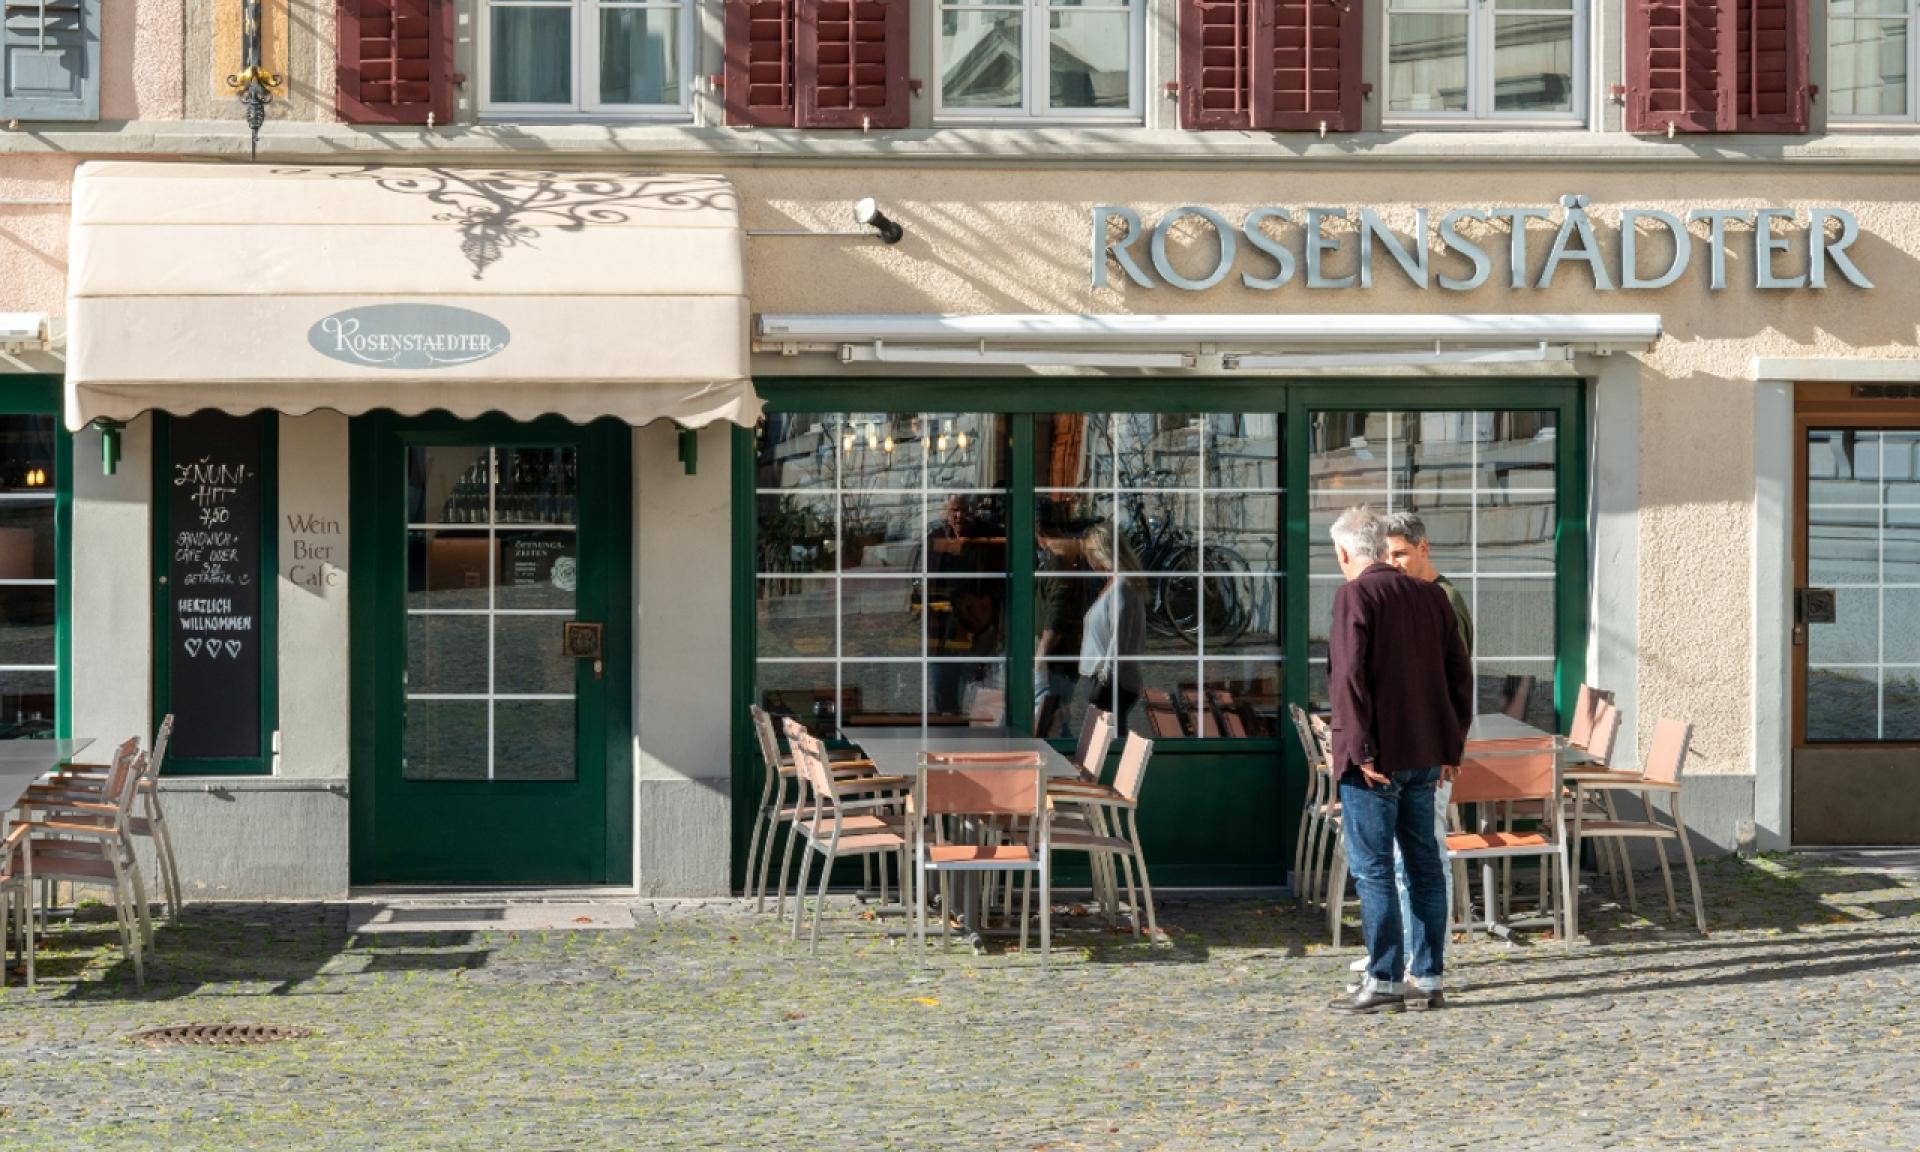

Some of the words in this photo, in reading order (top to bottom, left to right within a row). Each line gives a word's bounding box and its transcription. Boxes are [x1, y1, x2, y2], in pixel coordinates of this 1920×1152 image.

[1091, 194, 1876, 291] ROSENSTÄDTER
[287, 513, 344, 535] Wein
[293, 540, 334, 560] Bier
[178, 598, 232, 614] HERZLICH
